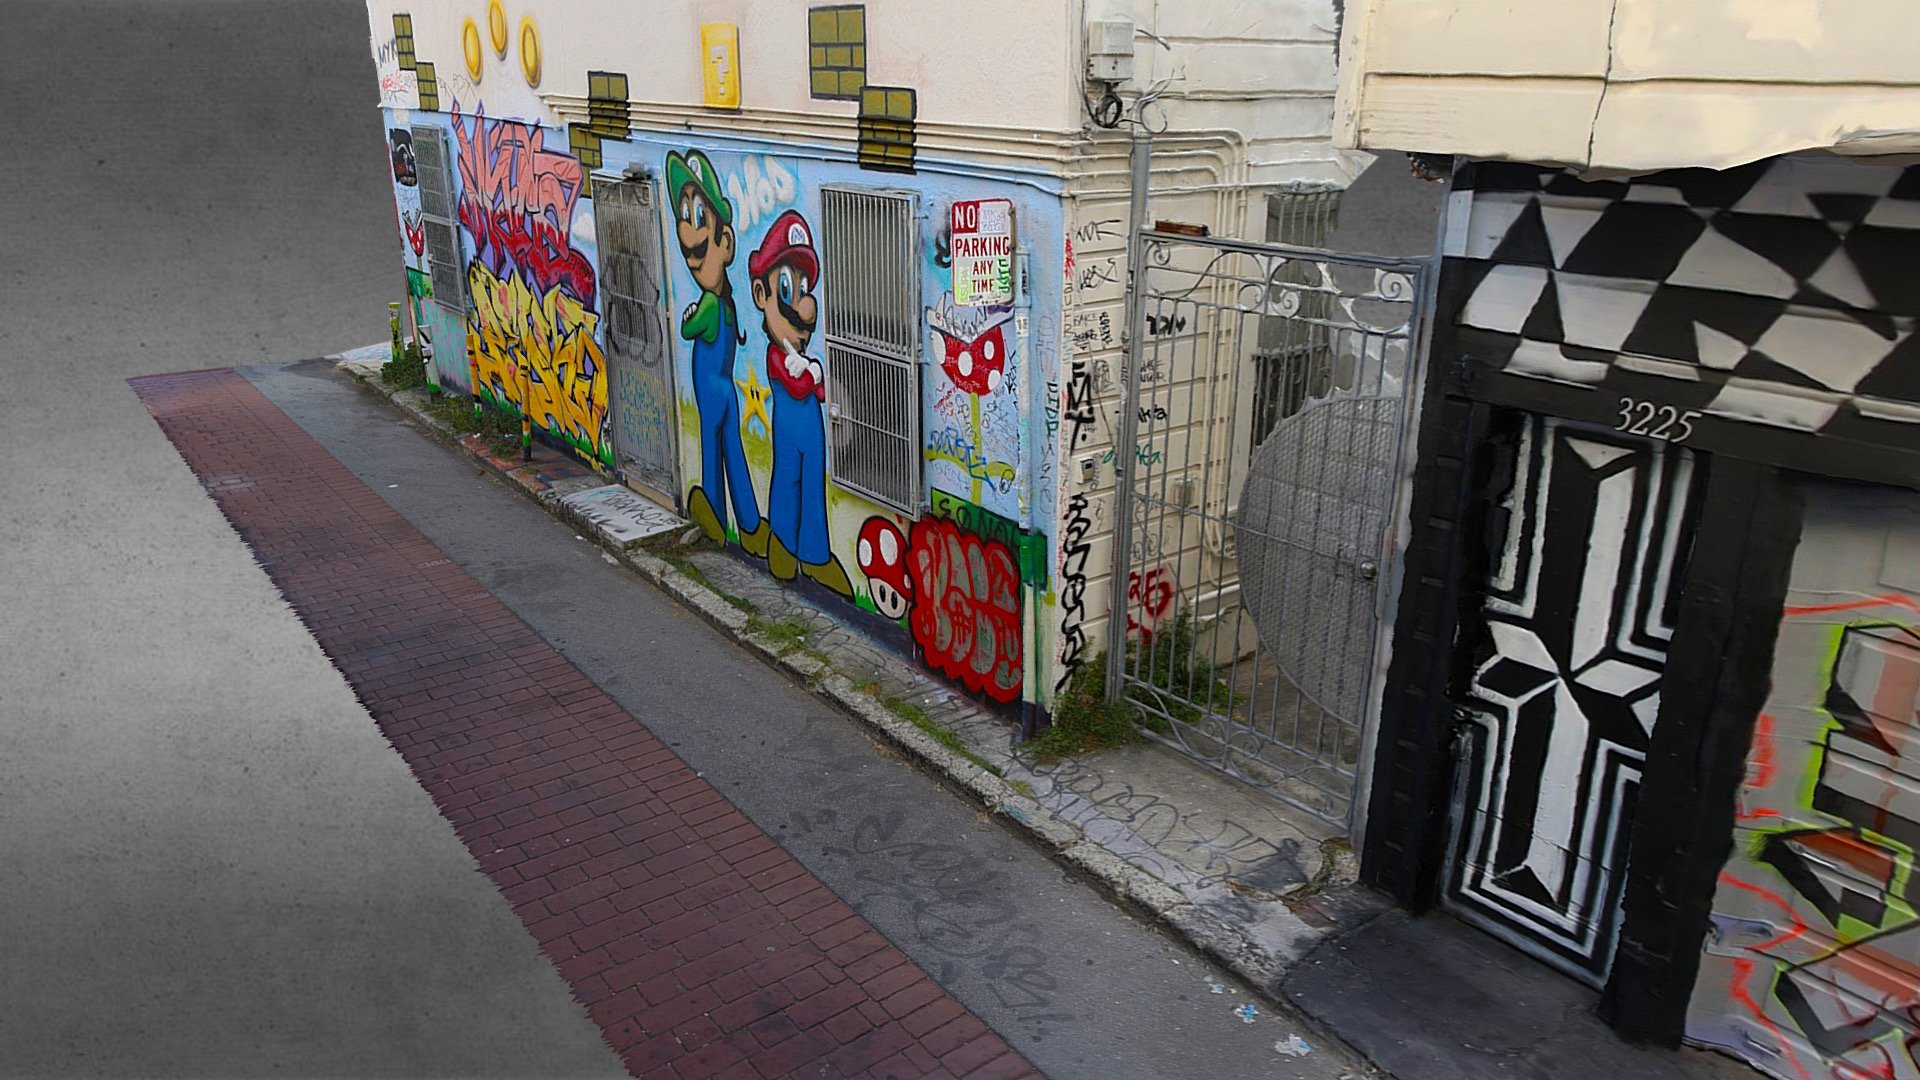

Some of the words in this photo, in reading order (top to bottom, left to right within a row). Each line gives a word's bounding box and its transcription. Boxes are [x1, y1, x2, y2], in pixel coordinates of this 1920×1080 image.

[954, 205, 977, 232] NO
[955, 236, 1010, 257] PARKING
[972, 260, 994, 276] ANY
[971, 279, 994, 294] TIME
[1614, 397, 1703, 443] 3225
